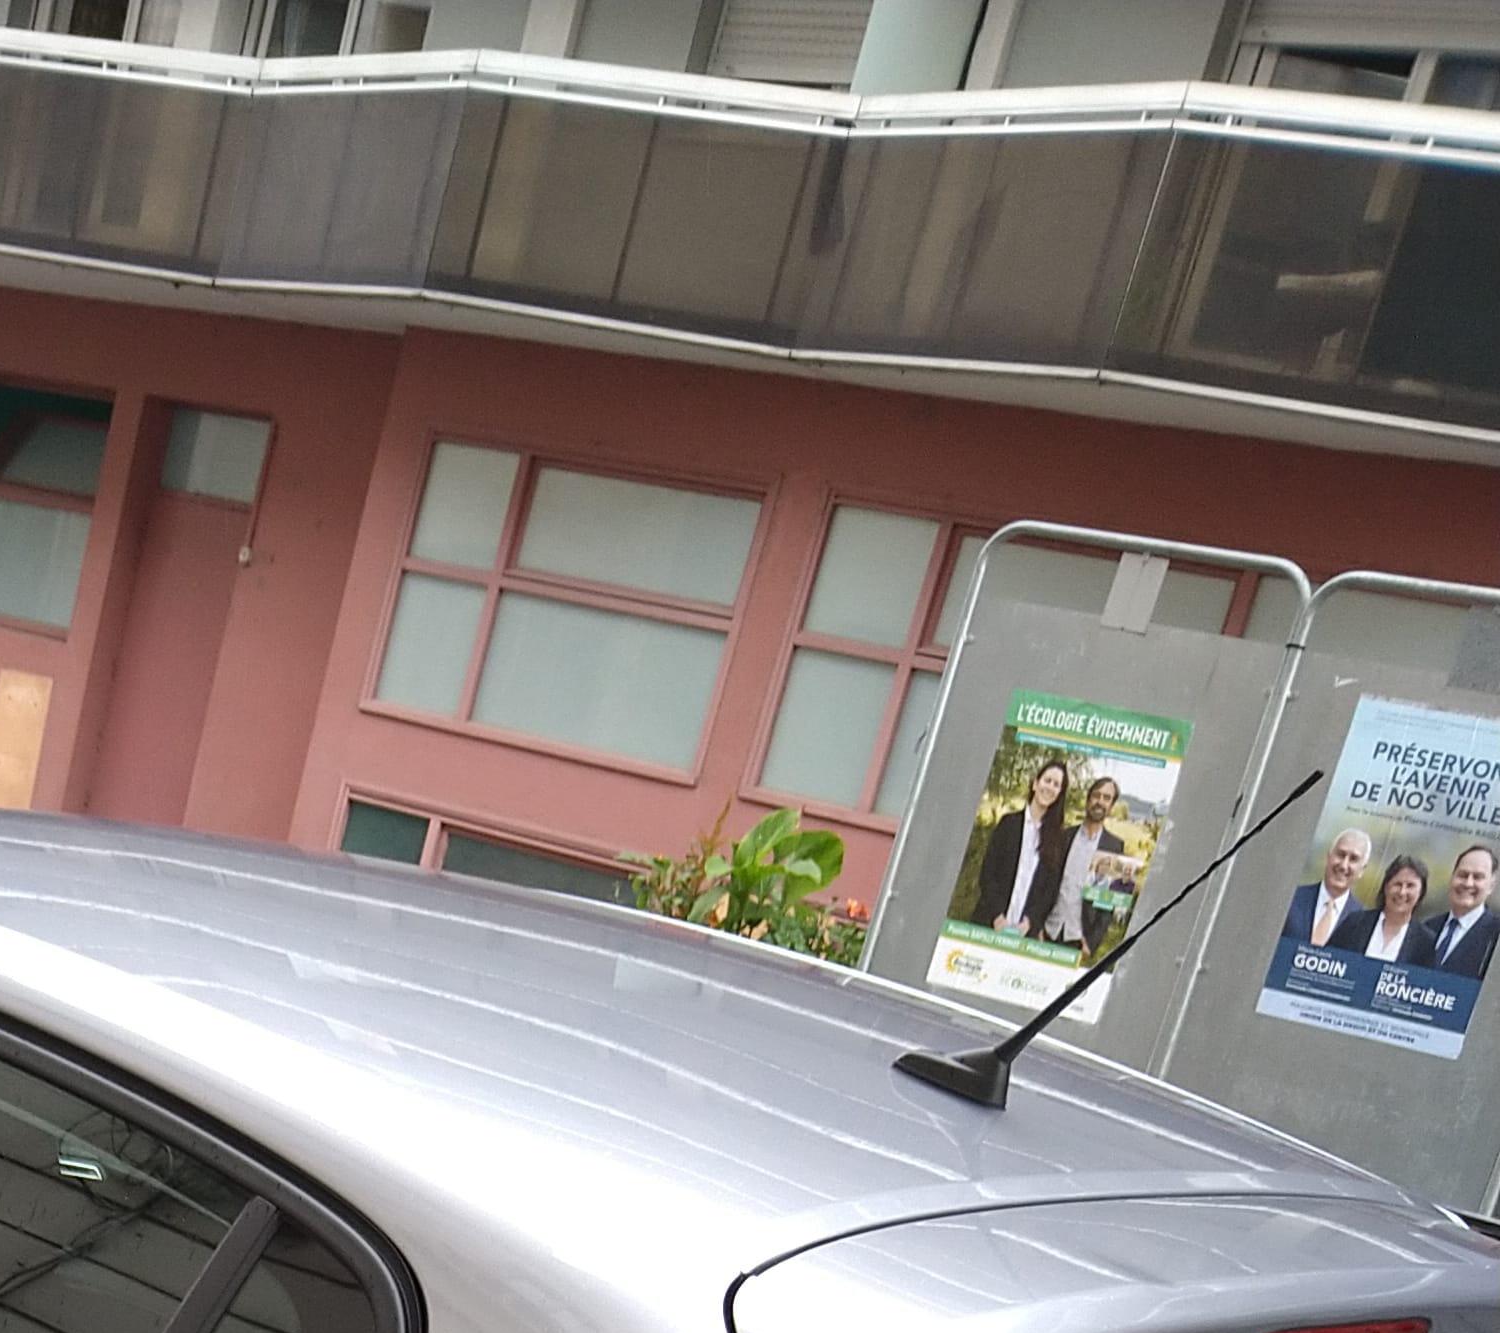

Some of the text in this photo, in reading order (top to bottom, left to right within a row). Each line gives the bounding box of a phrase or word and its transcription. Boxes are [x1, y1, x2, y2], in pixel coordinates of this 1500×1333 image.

[1017, 702, 1086, 733] L'ÉCOLOGIE
[1086, 713, 1170, 750] ÉVIDEMMENT
[1350, 780, 1382, 802] DE
[1387, 787, 1437, 813] NOS
[1391, 766, 1491, 801] L'AVENIR
[1293, 953, 1347, 978] GODIN
[1380, 971, 1407, 985] DE LA
[1375, 981, 1456, 1011] RONCIÈRE
